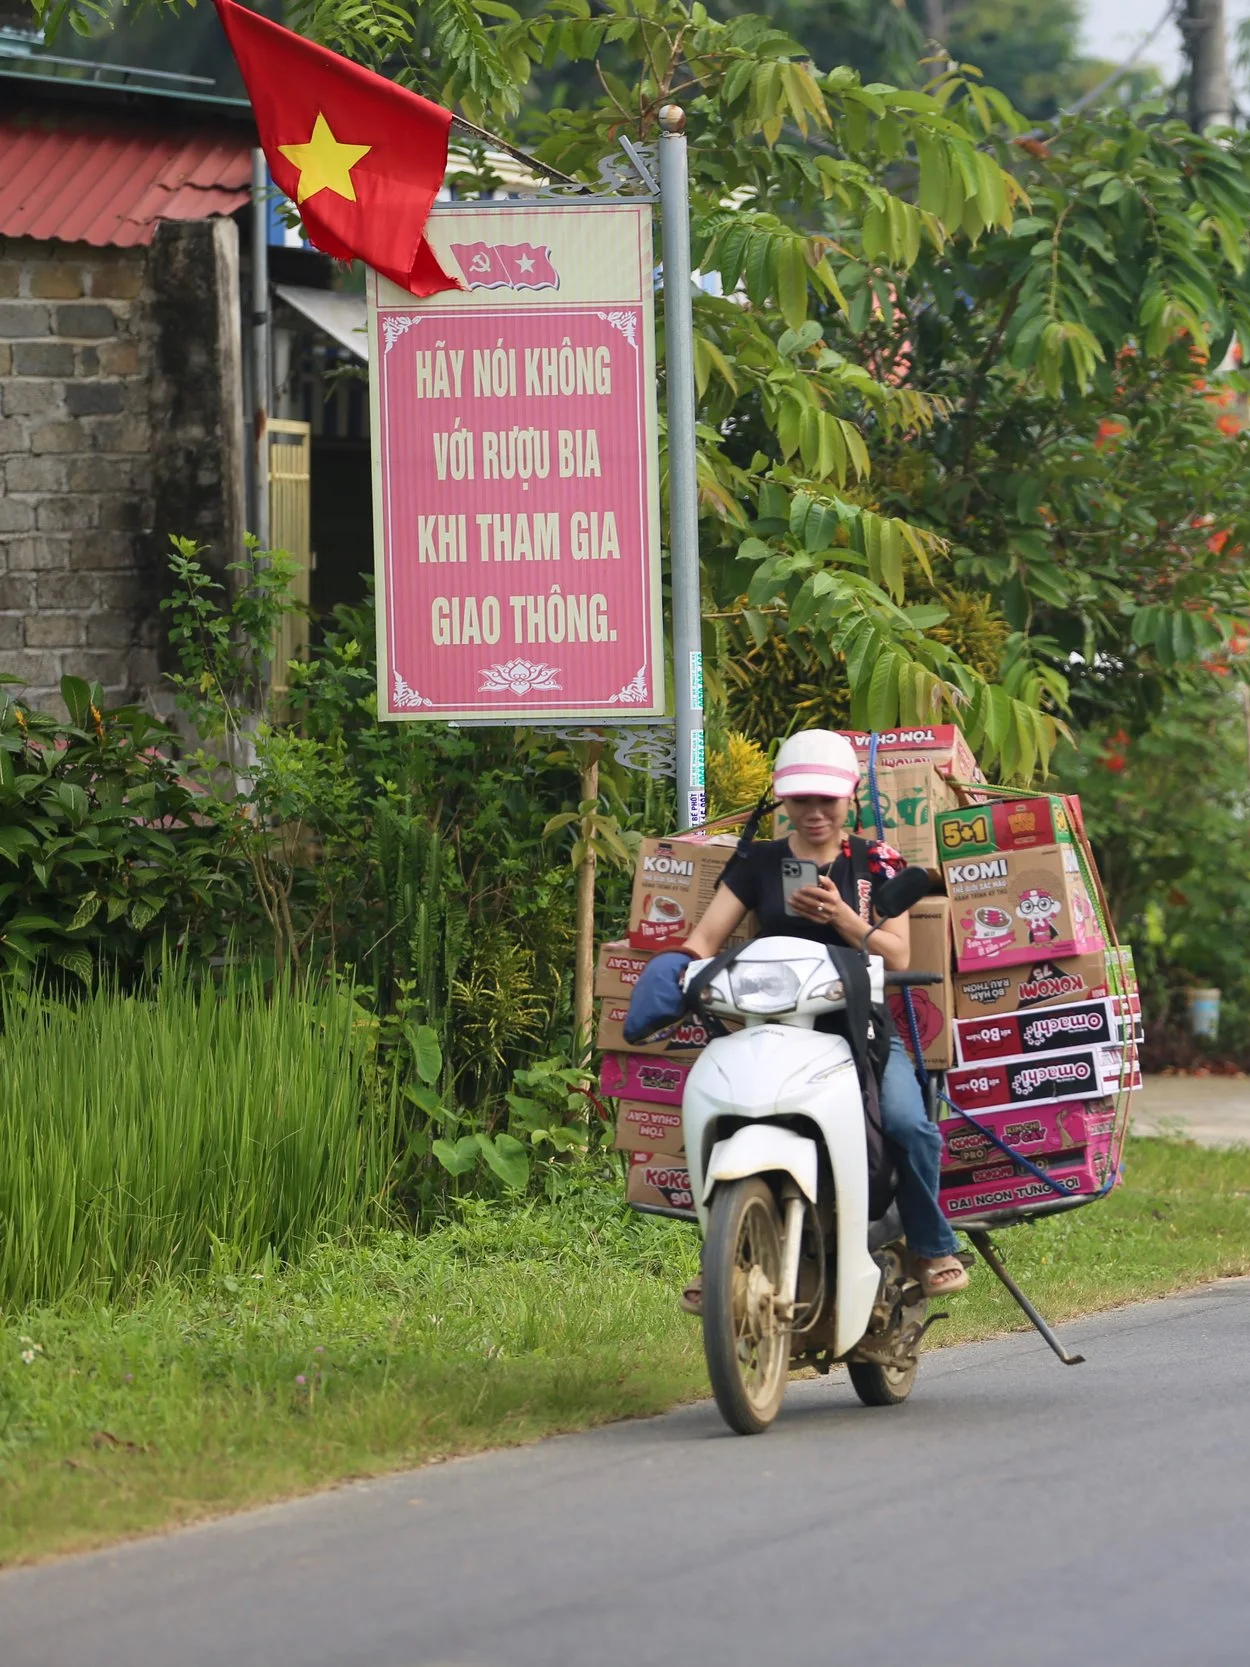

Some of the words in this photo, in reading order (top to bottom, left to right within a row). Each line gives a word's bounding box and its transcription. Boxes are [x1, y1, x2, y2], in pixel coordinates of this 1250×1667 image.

[416, 340, 464, 399] HÃY
[473, 338, 517, 397] NÓI
[525, 336, 612, 396] KHÔNG
[433, 417, 474, 480] VỚI
[482, 426, 551, 490] RƯỢU
[558, 429, 602, 478] BIA
[417, 514, 467, 563] KHI
[476, 512, 561, 561] THAM
[570, 511, 621, 559] GIA
[431, 596, 501, 645] GIAO
[510, 584, 618, 643] THÔNG.
[899, 730, 935, 744] TÔM
[942, 815, 989, 849] 5+1
[643, 856, 694, 876] KOMI
[948, 859, 1008, 884] KOMI
[607, 957, 630, 969] CAY
[1032, 963, 1053, 981] 75
[1018, 974, 1084, 999] KOKOMI
[980, 1027, 1001, 1043] Bò
[1032, 1012, 1103, 1038] Omachi
[1020, 1061, 1091, 1087] Omachi
[969, 1077, 989, 1093] Bò
[628, 1110, 650, 1123] CAY
[651, 1114, 681, 1126] CHUA
[640, 1125, 664, 1139] TÔM
[963, 1150, 984, 1160] PRO
[645, 1168, 692, 1190] KOKO
[671, 1191, 691, 1205] 90
[949, 1198, 972, 1211] DAI
[975, 1190, 1012, 1206] NGON
